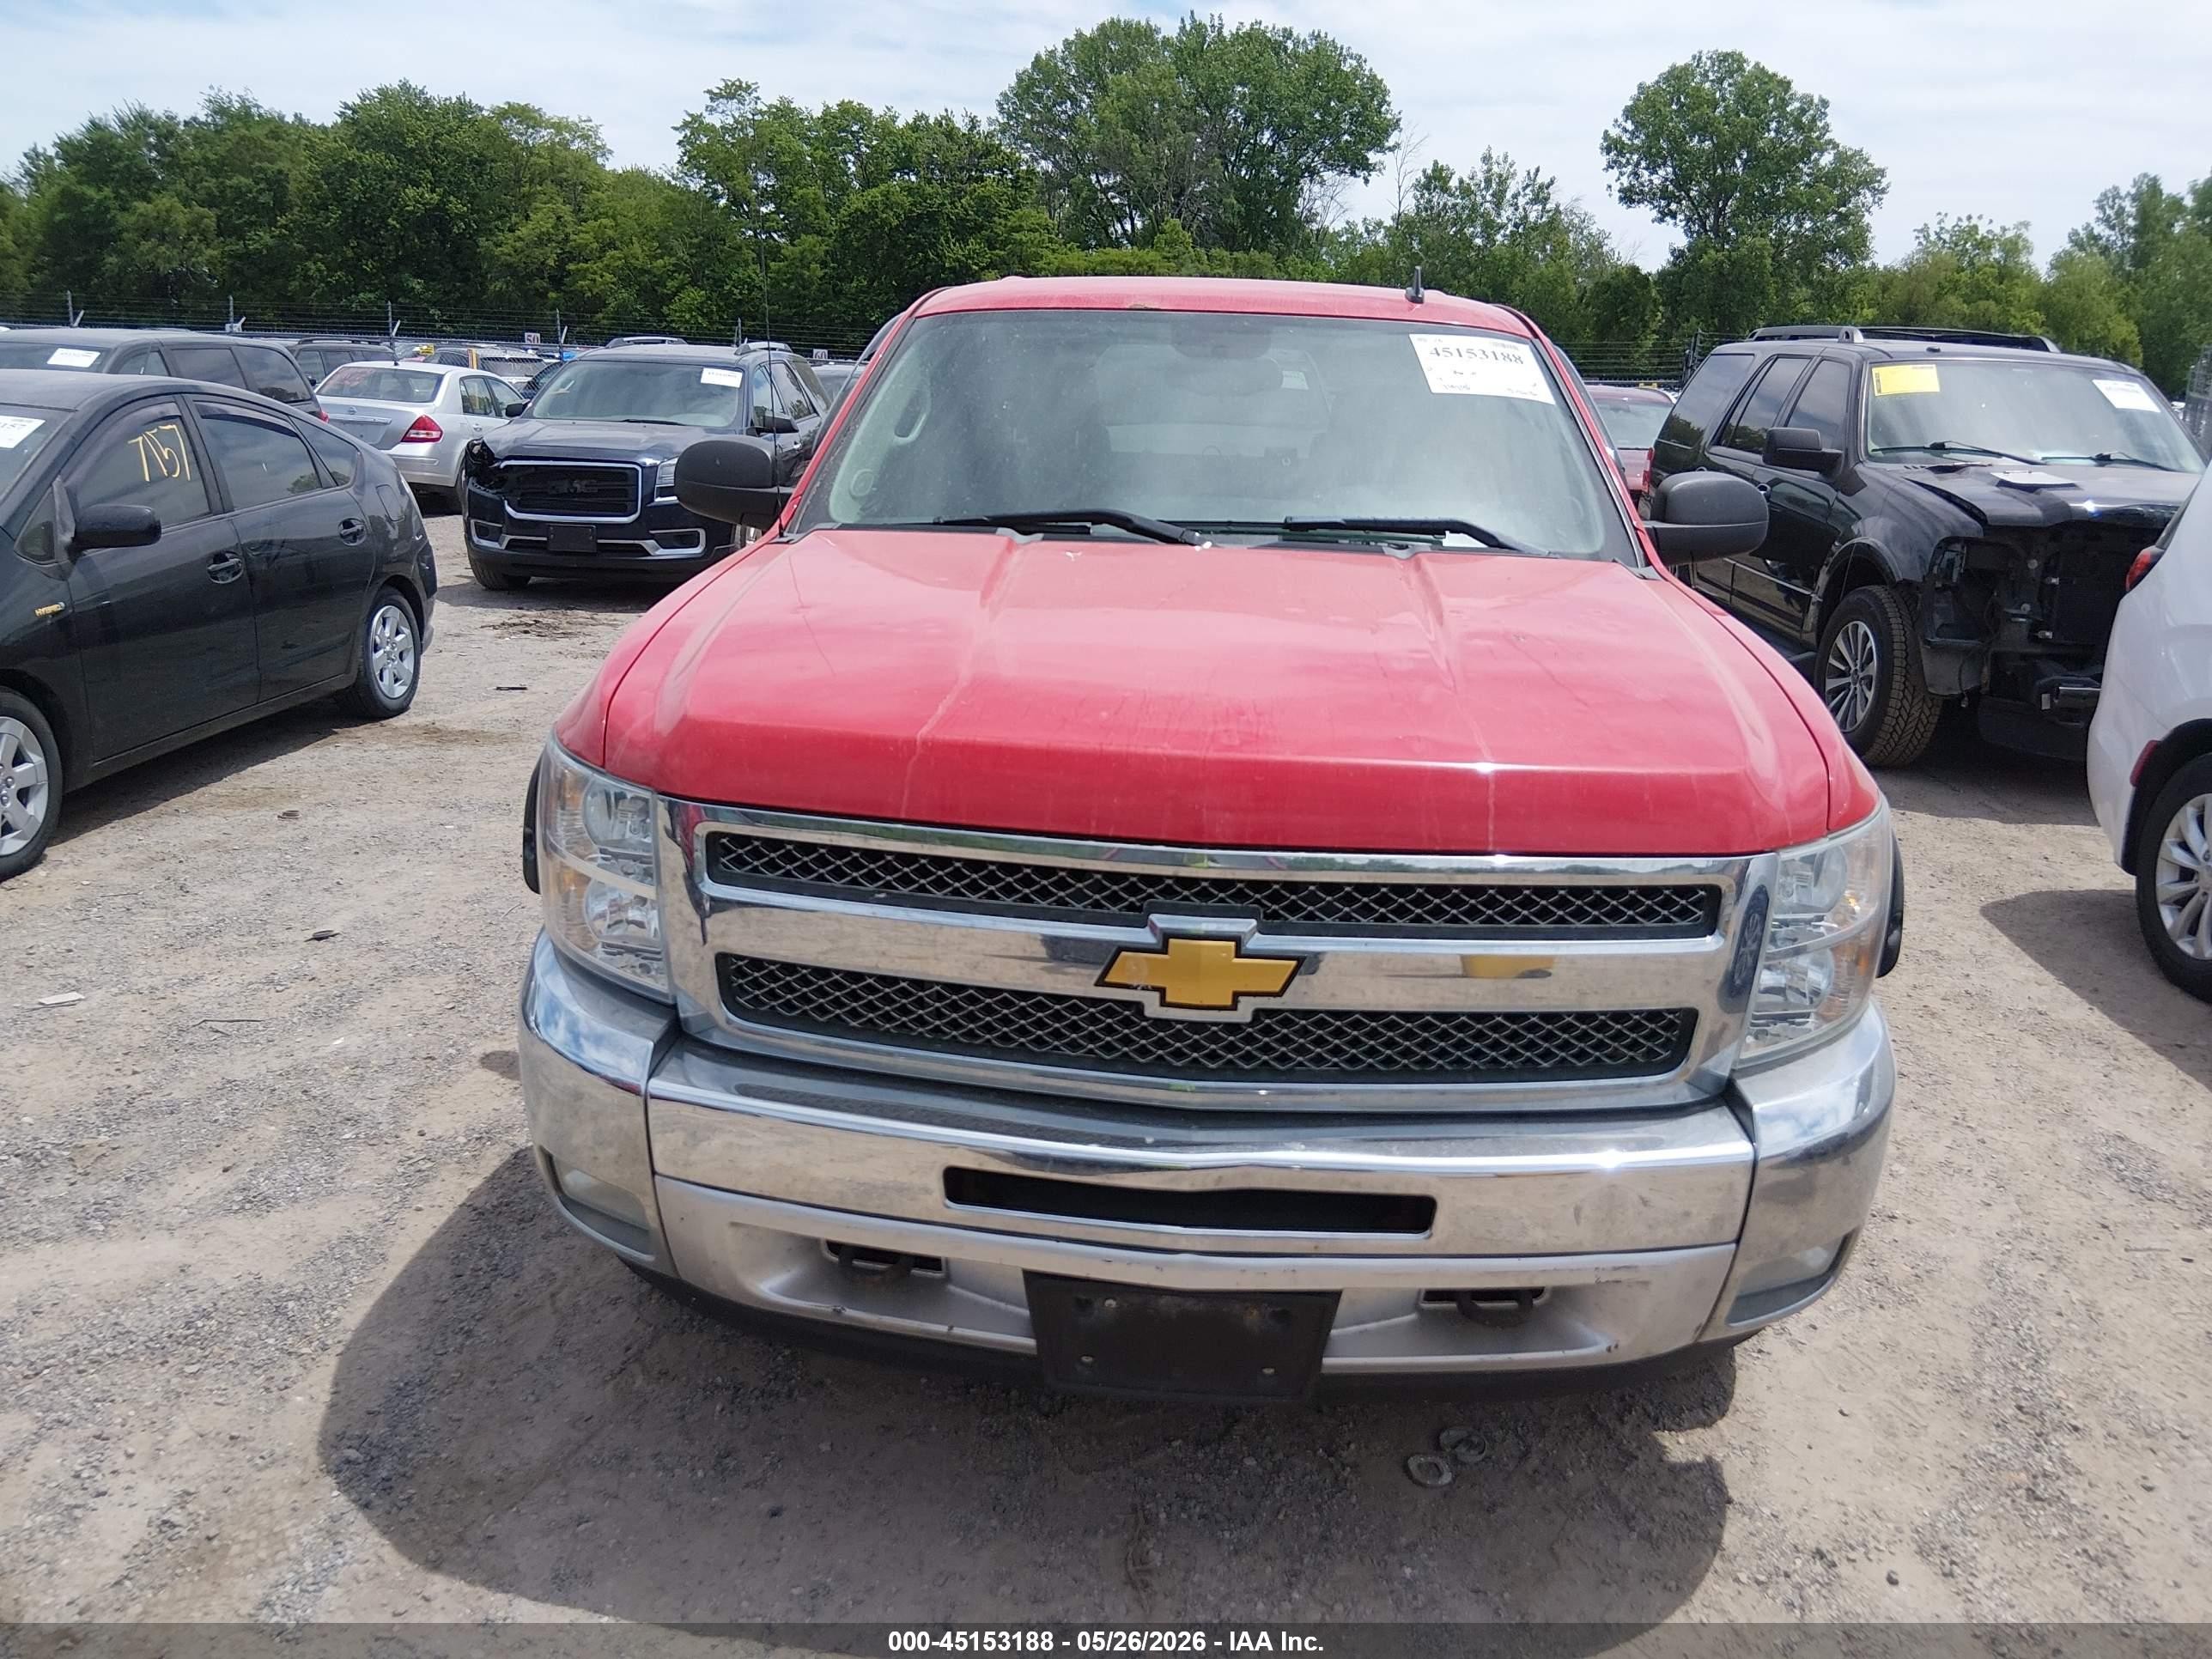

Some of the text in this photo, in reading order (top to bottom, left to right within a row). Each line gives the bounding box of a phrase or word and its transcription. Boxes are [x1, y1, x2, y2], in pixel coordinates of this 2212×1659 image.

[526, 334, 539, 343] 50
[1429, 346, 1524, 365] 45153188
[127, 424, 191, 482] 7157
